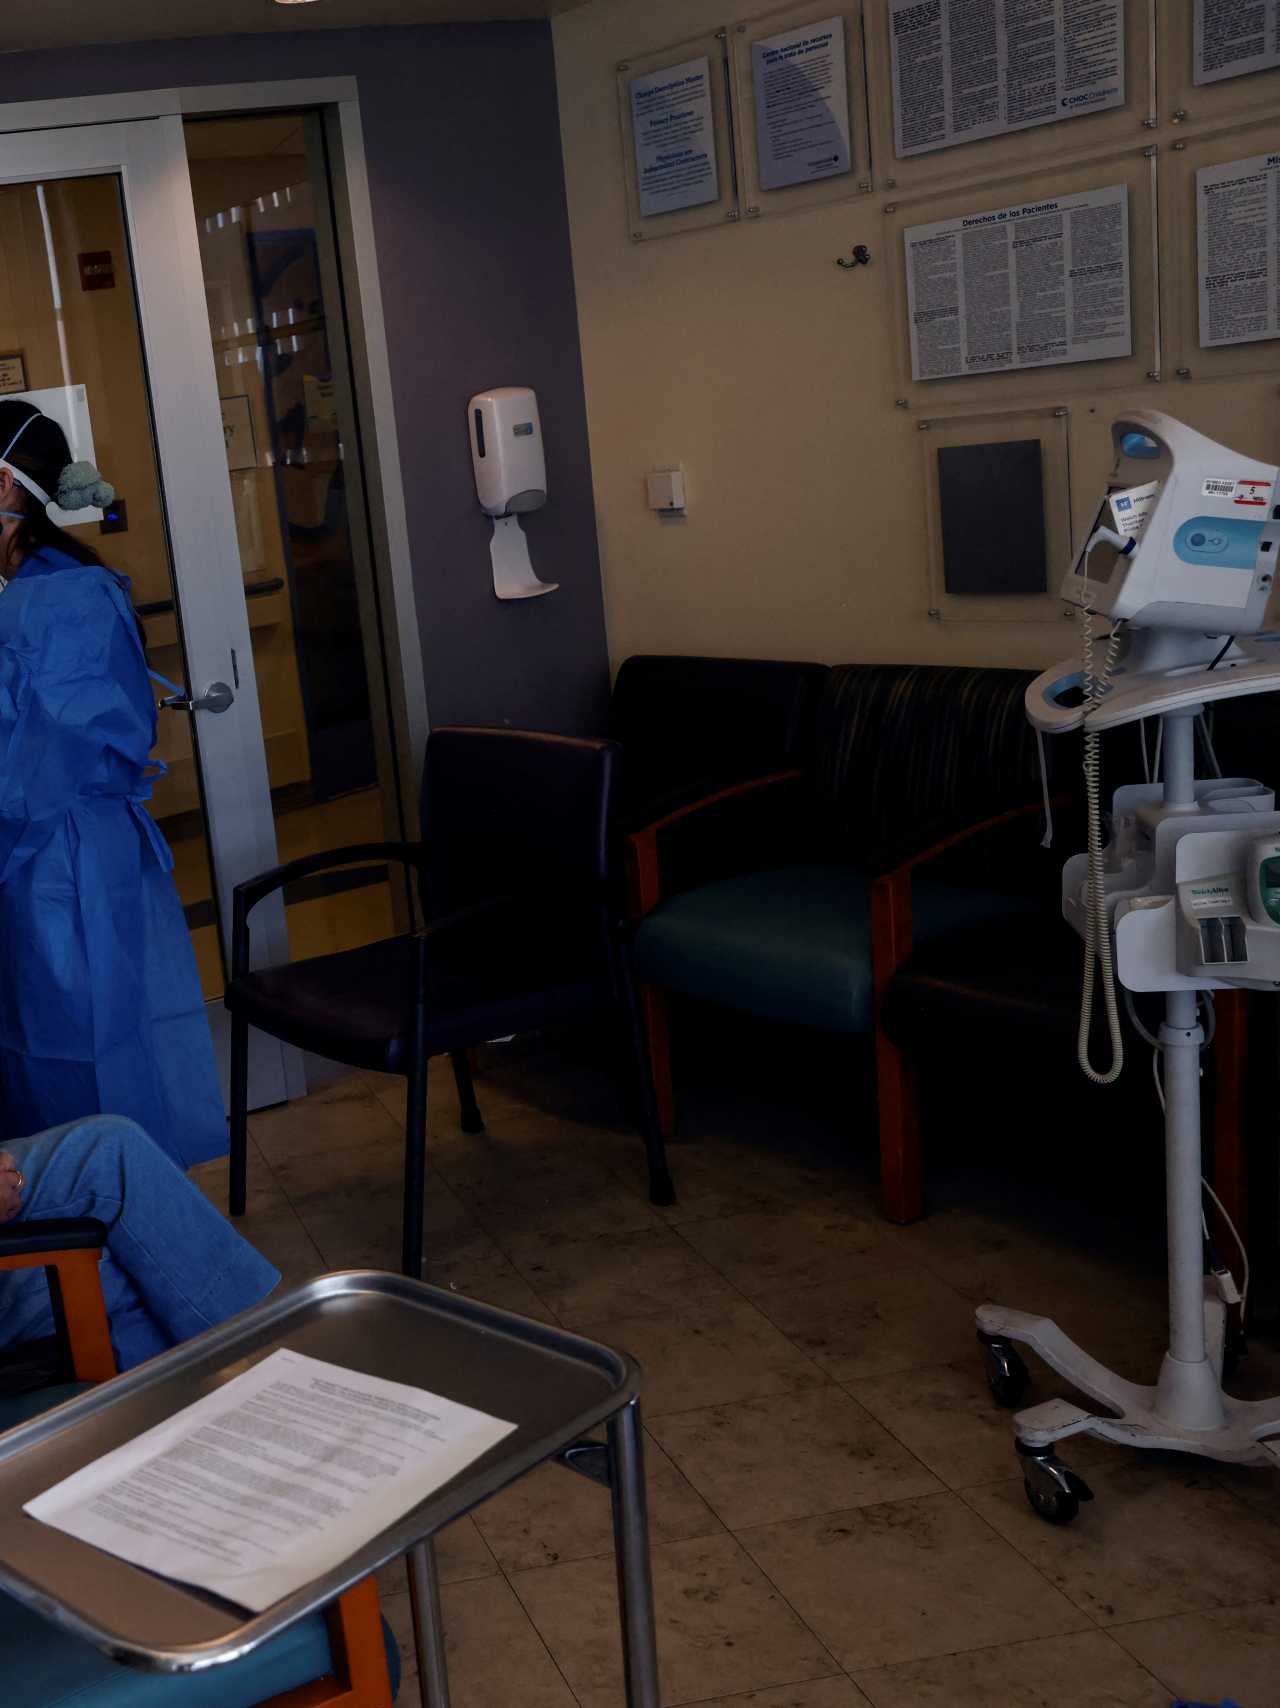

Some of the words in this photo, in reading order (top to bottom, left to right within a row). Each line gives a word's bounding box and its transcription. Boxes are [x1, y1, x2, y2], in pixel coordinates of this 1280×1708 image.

[962, 214, 996, 227] Derechos
[997, 212, 1007, 220] de
[1009, 209, 1020, 218] los
[1022, 202, 1058, 216] Pacientes
